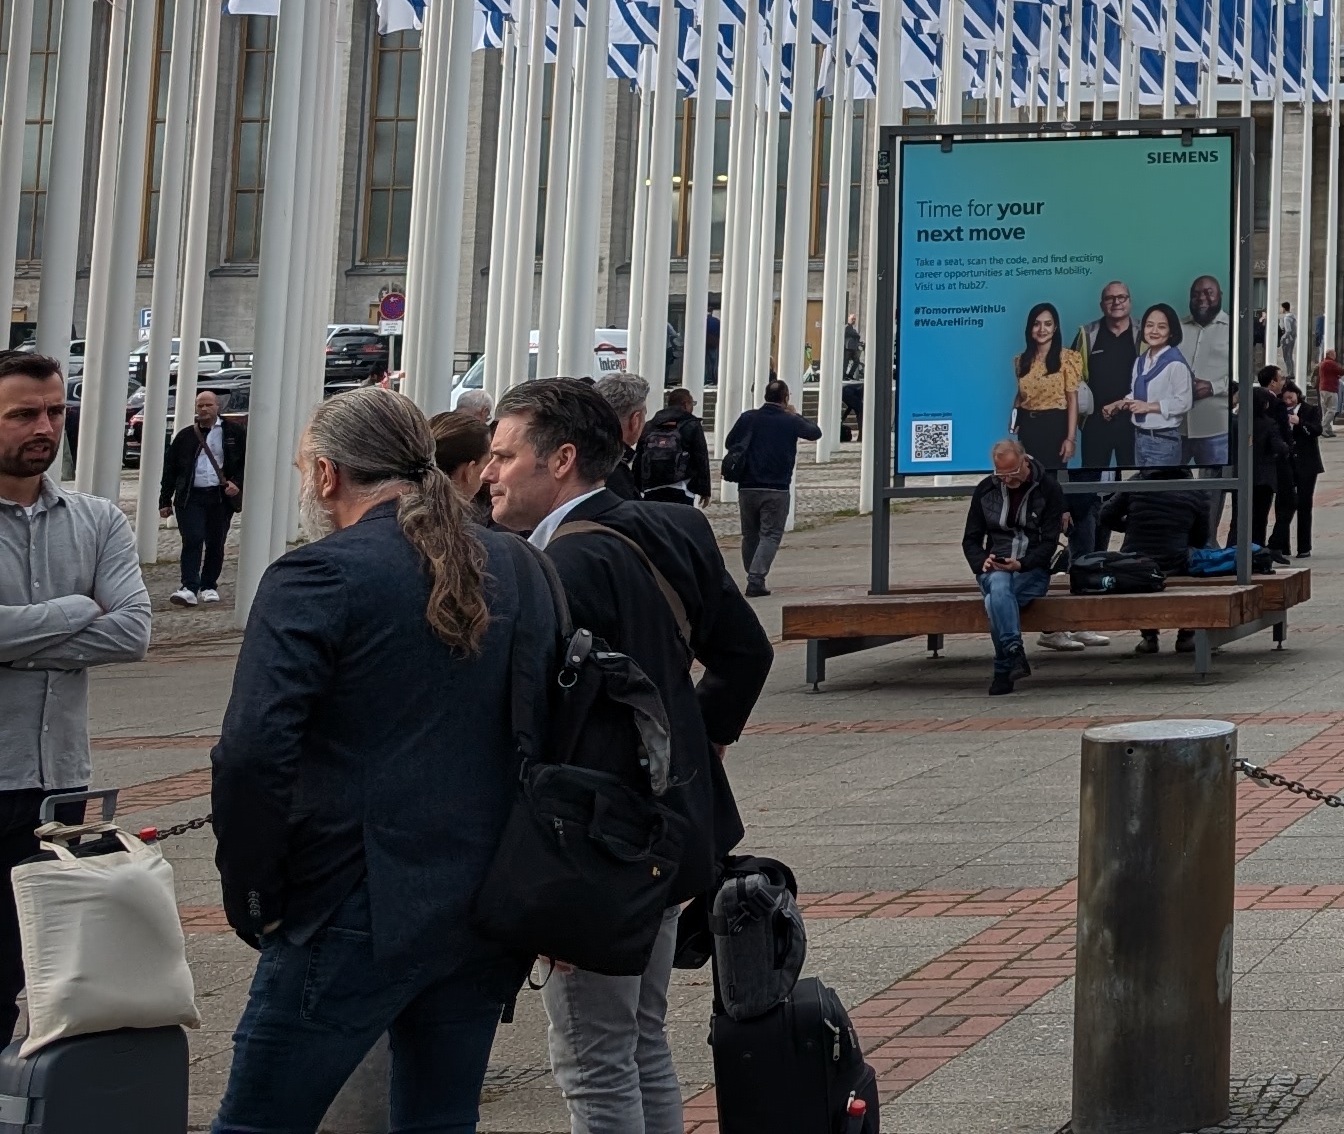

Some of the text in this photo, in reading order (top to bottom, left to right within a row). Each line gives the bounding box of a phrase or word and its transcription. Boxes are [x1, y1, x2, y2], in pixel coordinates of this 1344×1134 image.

[1147, 150, 1219, 164] SIEMENS
[916, 199, 1045, 220] Time for your
[916, 226, 1025, 242] next move
[915, 258, 934, 267] Take
[967, 257, 986, 265] scan
[989, 256, 1004, 265] the
[1005, 255, 1029, 265] code,
[1031, 254, 1049, 264] and
[1050, 254, 1067, 263] find
[1069, 253, 1104, 264] exciting
[915, 270, 942, 279] career
[944, 268, 1003, 280] opportunities
[1004, 269, 1014, 277] at
[1015, 267, 1053, 277] Siemens
[915, 280, 988, 291] Visit us at hub27.
[914, 305, 1006, 315] #TomorrowWithUs
[914, 317, 984, 328] #WeAreHiring
